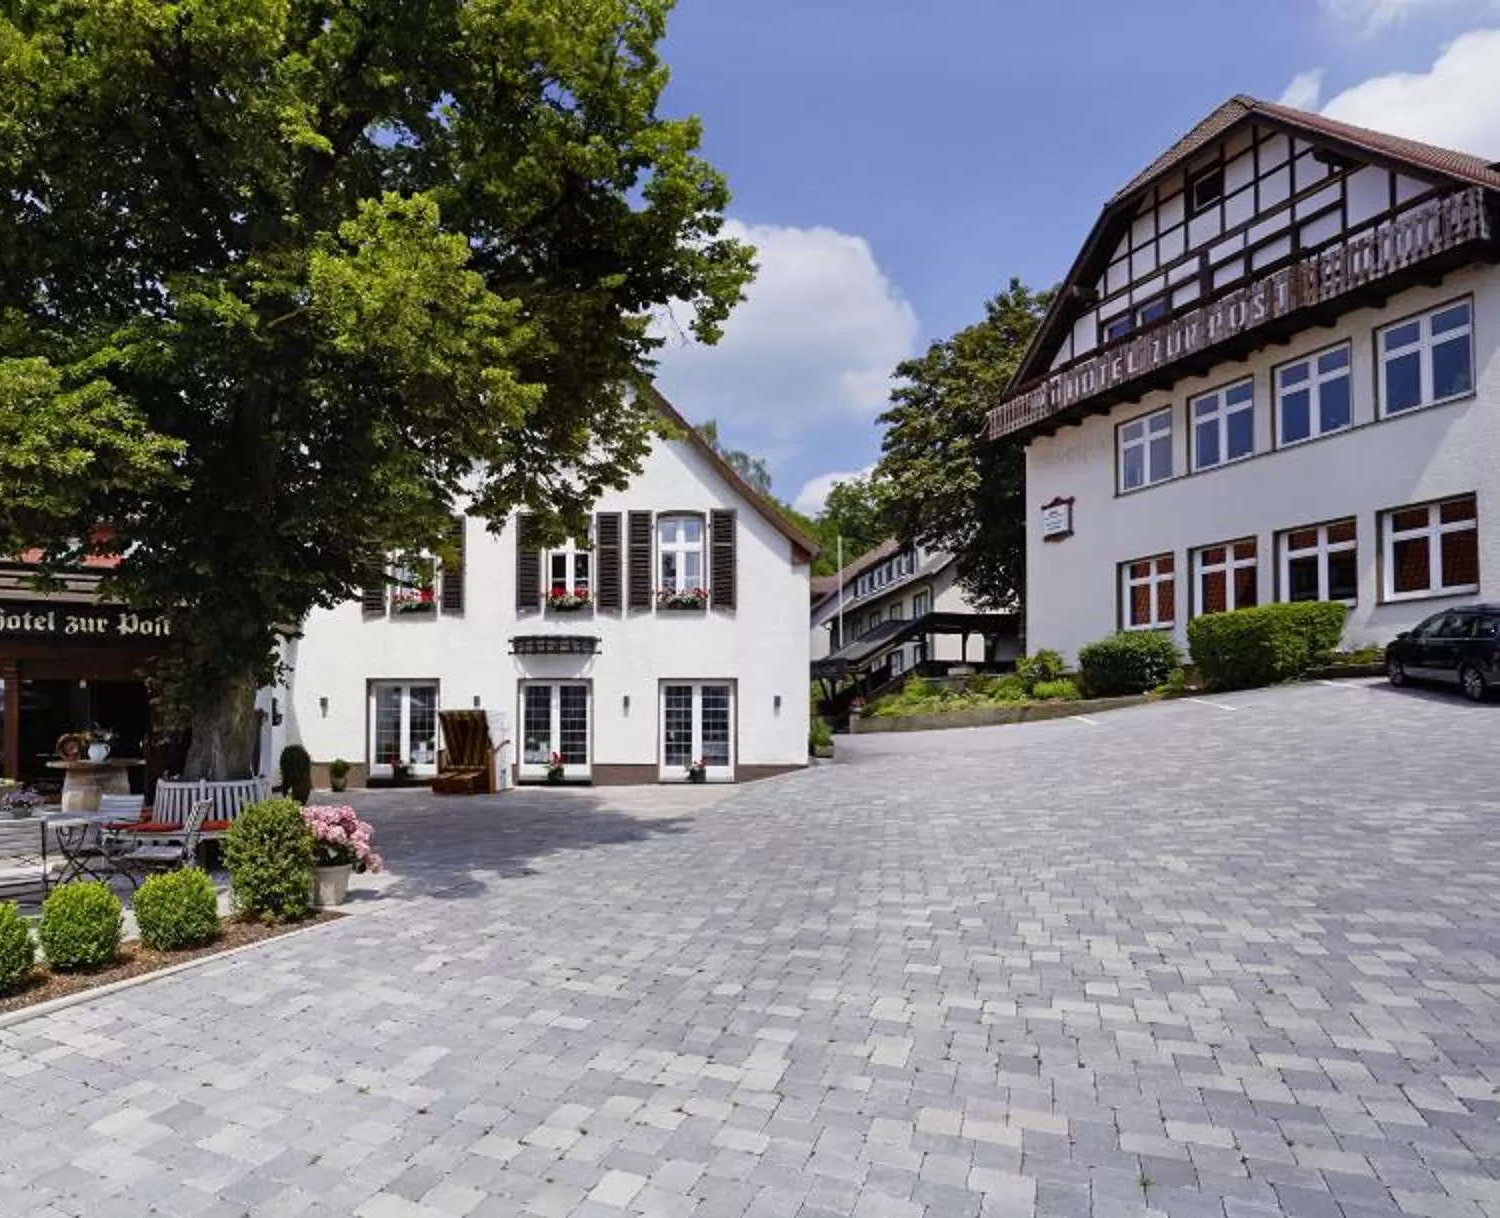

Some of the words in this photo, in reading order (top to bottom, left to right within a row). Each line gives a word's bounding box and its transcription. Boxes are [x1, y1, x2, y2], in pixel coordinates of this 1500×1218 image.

[1067, 352, 1139, 399] HOTEL
[1152, 322, 1198, 363] ZUR
[1209, 281, 1287, 339] POST
[64, 615, 109, 635] zur
